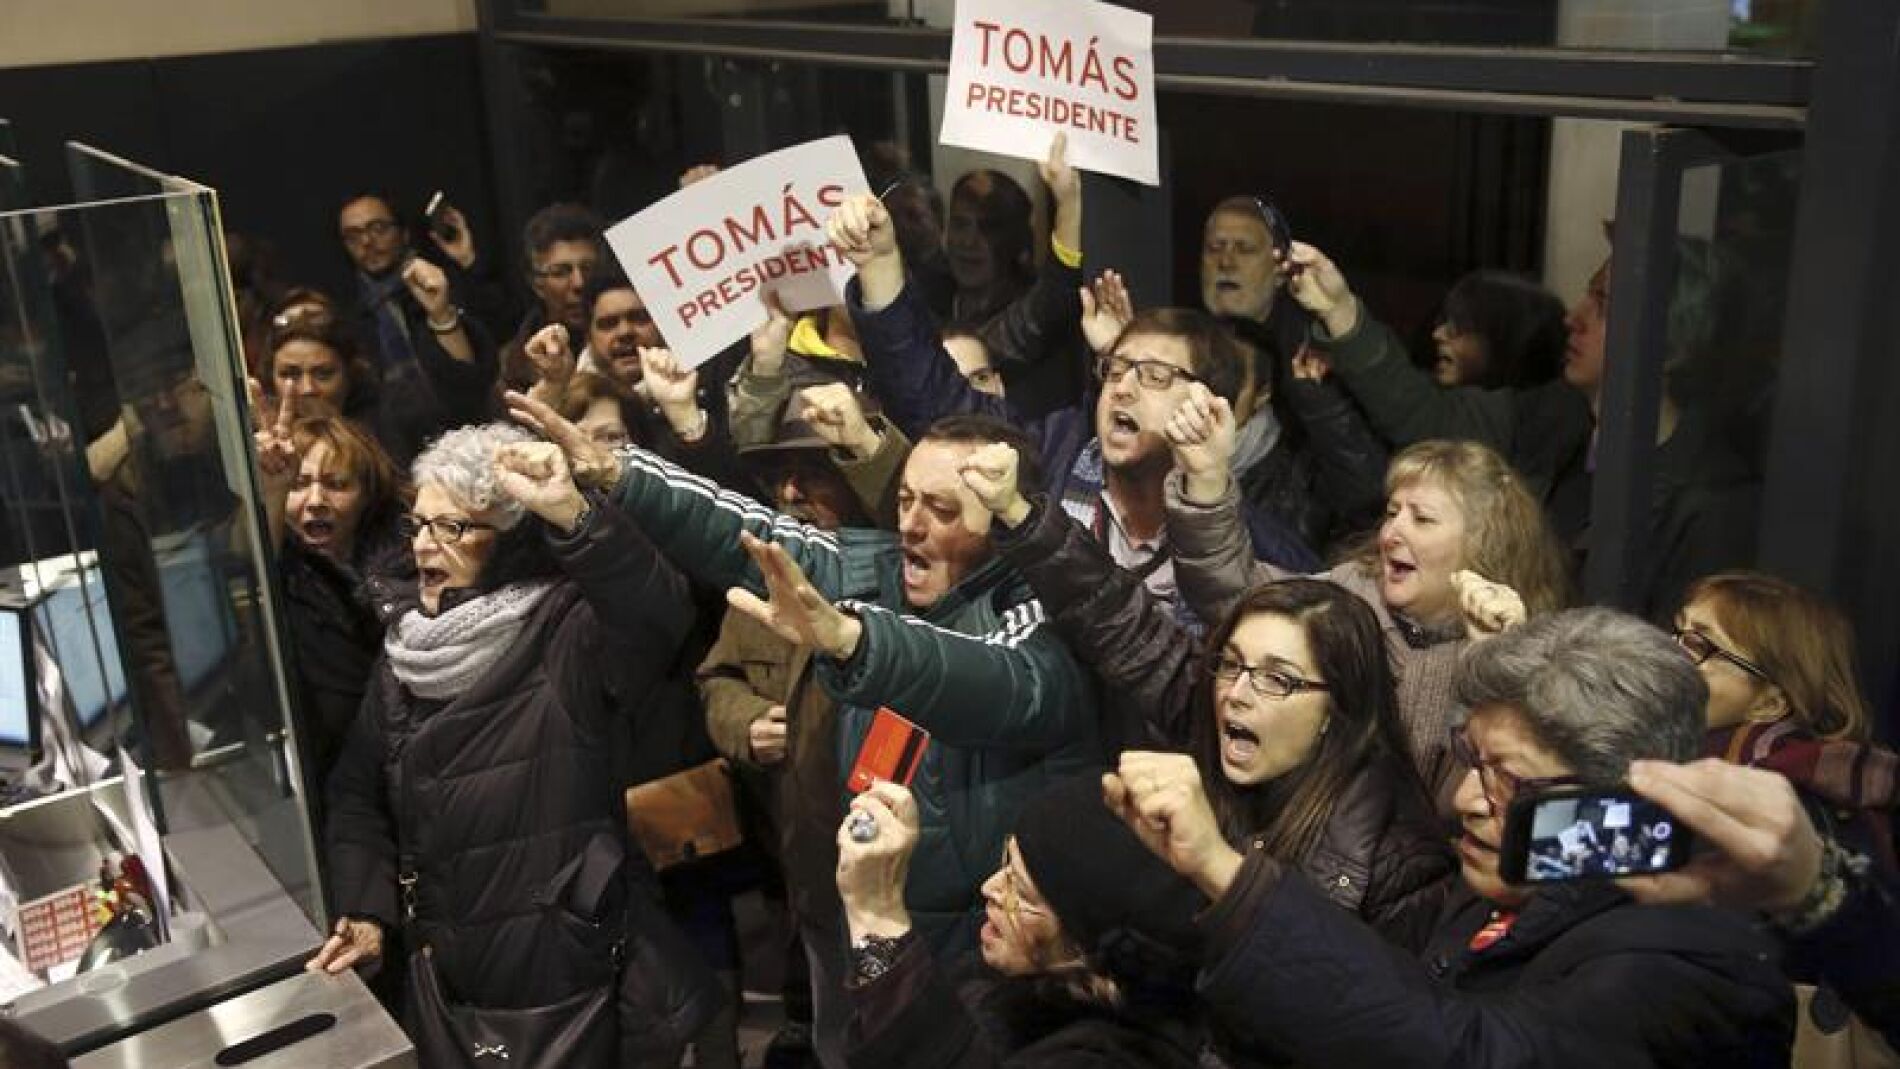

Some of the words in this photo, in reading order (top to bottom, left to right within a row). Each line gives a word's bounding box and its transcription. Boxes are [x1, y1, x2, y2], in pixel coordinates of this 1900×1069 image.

[973, 20, 1139, 101] TOMÁS
[966, 82, 1139, 143] PRESIDENTE
[676, 240, 850, 329] PRESIDENT
